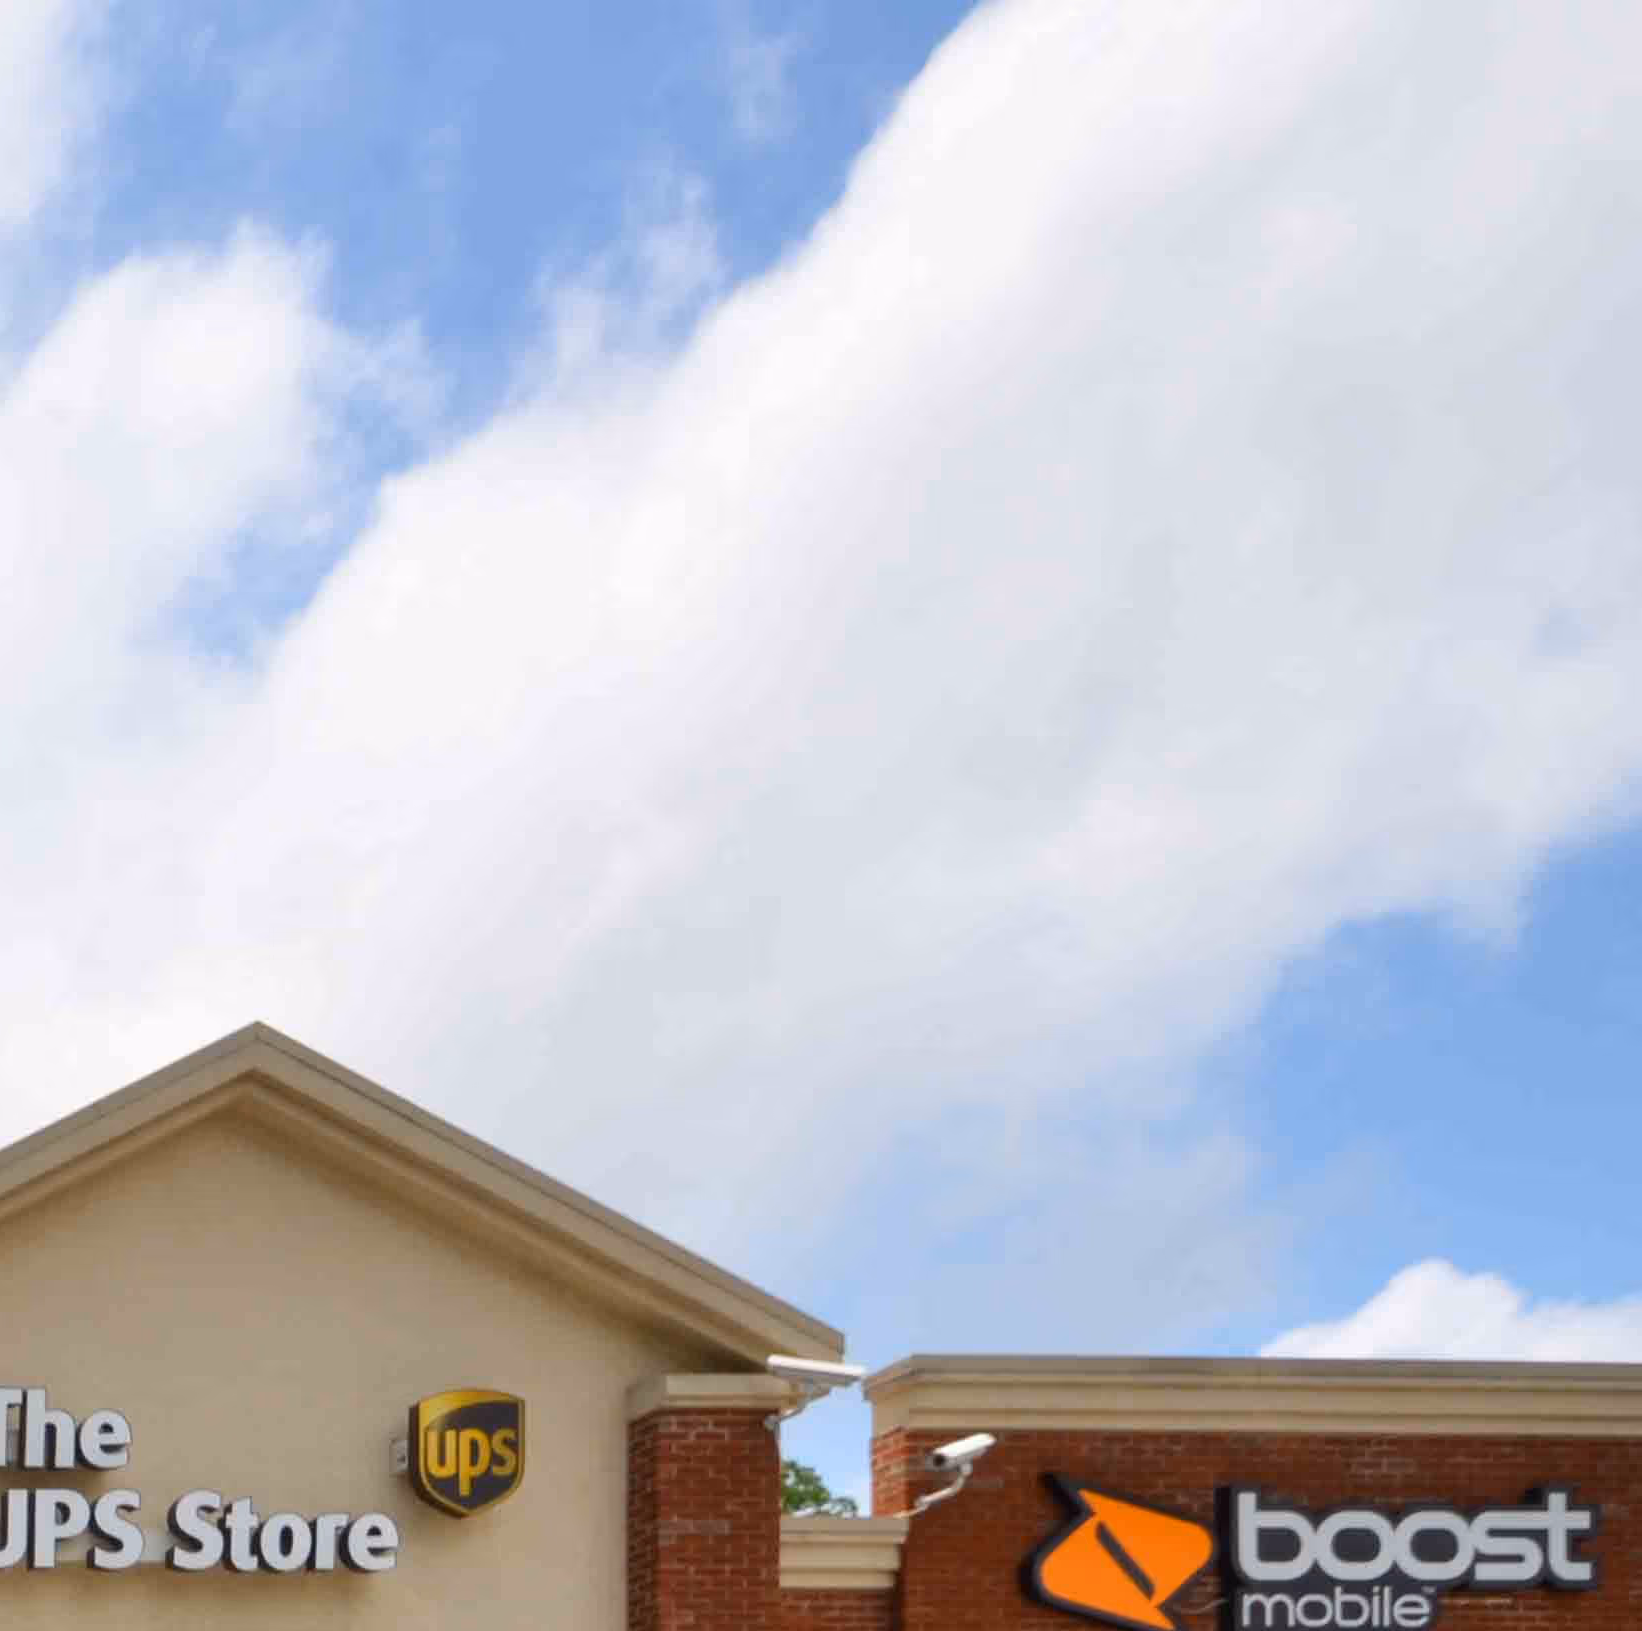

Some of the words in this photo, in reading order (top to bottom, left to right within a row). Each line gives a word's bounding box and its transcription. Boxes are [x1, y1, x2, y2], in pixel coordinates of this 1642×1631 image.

[426, 1428, 518, 1497] ups
[171, 1491, 399, 1572] Store
[1238, 1492, 1591, 1580] boost
[1242, 1586, 1430, 1627] mobile
